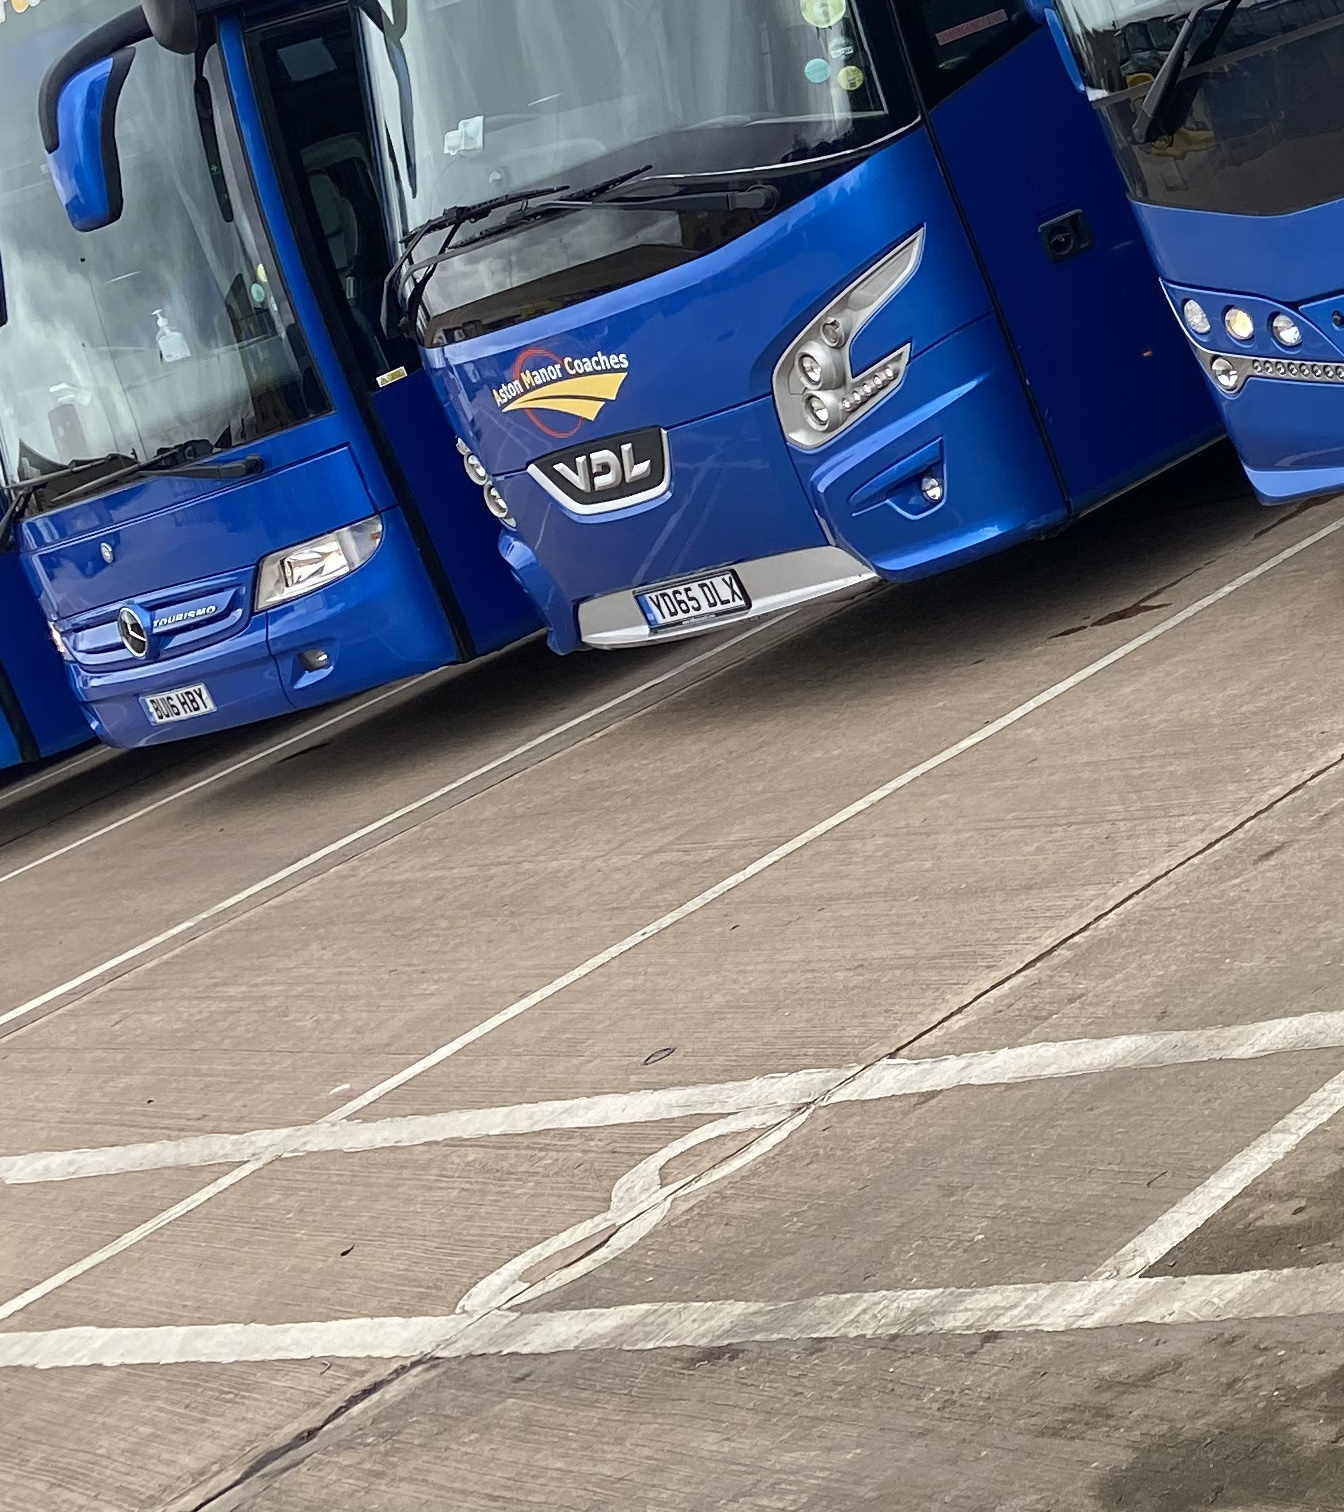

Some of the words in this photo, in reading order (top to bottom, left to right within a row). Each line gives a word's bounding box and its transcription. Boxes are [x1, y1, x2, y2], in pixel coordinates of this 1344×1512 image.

[492, 379, 524, 408] Aston
[520, 363, 563, 390] Manor
[563, 351, 629, 375] Coaches
[552, 443, 651, 493] VDL
[648, 586, 702, 620] YD65
[697, 575, 743, 608] DLX
[149, 695, 181, 721] BU16
[175, 687, 208, 715] HBY
